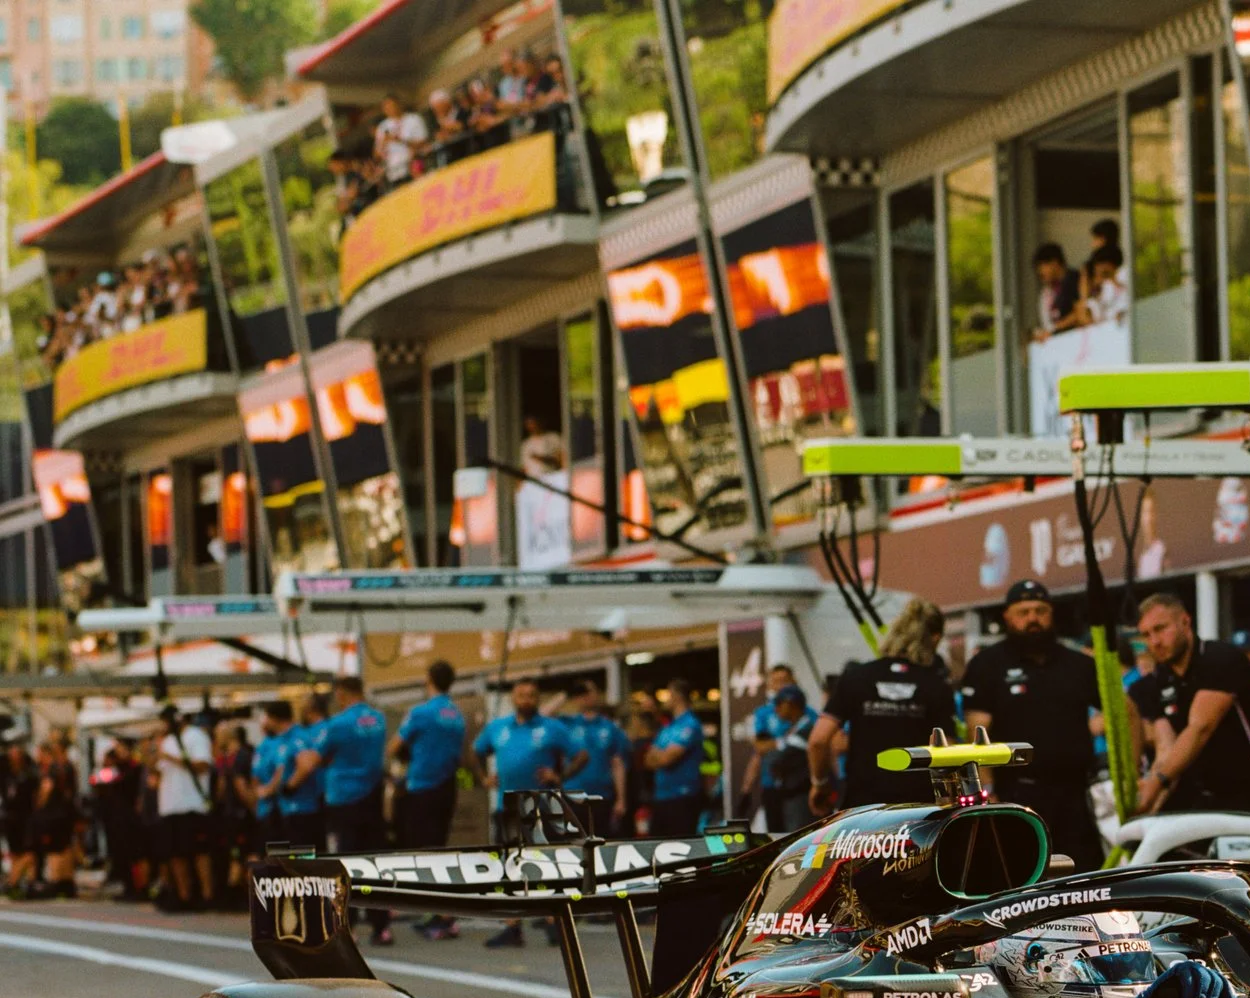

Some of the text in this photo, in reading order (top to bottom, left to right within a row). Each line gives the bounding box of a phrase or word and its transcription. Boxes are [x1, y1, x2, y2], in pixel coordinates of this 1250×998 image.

[830, 824, 910, 859] Microsoft
[259, 876, 337, 900] CROWDSTRIKE
[990, 887, 1112, 922] CROWDSTRIKE
[755, 912, 815, 936] SOLERA
[1033, 923, 1094, 933] ROWDSTRIKE
[886, 927, 919, 957] AMD
